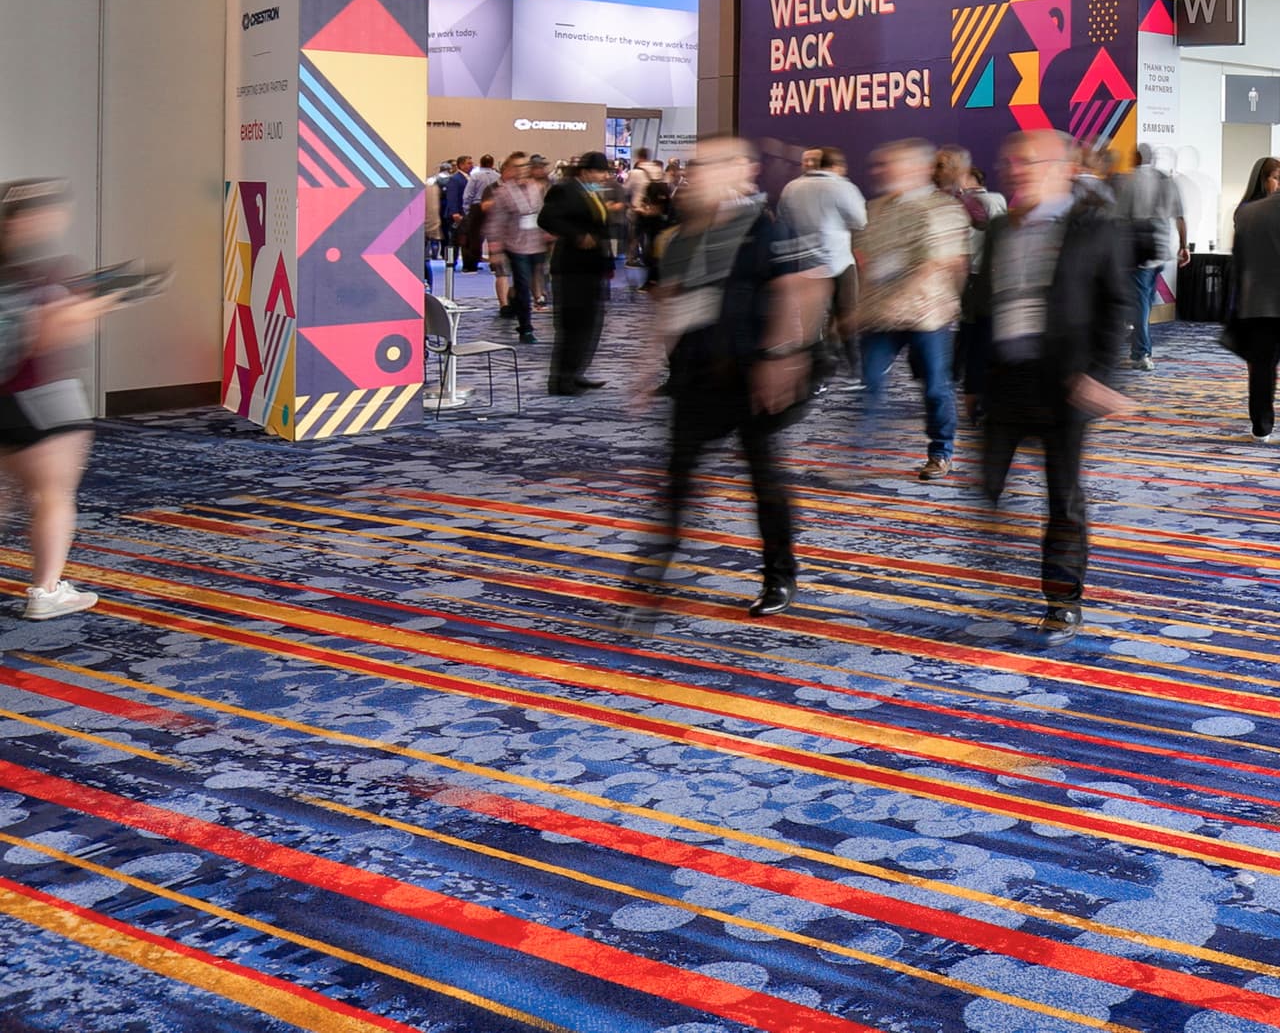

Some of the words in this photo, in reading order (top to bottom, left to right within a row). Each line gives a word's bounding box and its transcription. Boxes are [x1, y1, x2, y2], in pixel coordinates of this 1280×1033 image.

[554, 30, 604, 42] Innovations
[605, 34, 617, 44] for
[619, 36, 632, 45] the
[634, 40, 650, 48] way
[665, 40, 683, 49] work
[769, 31, 835, 72] BACK
[1143, 63, 1162, 72] THANK
[1164, 65, 1176, 73] YOU
[1158, 75, 1170, 83] OUR
[768, 68, 932, 116] #AVTWEEPS!
[1145, 84, 1173, 94] PARTNERS
[241, 119, 263, 141] exertis
[532, 120, 587, 131] CRESTRON
[1142, 123, 1175, 134] SAMSUNG
